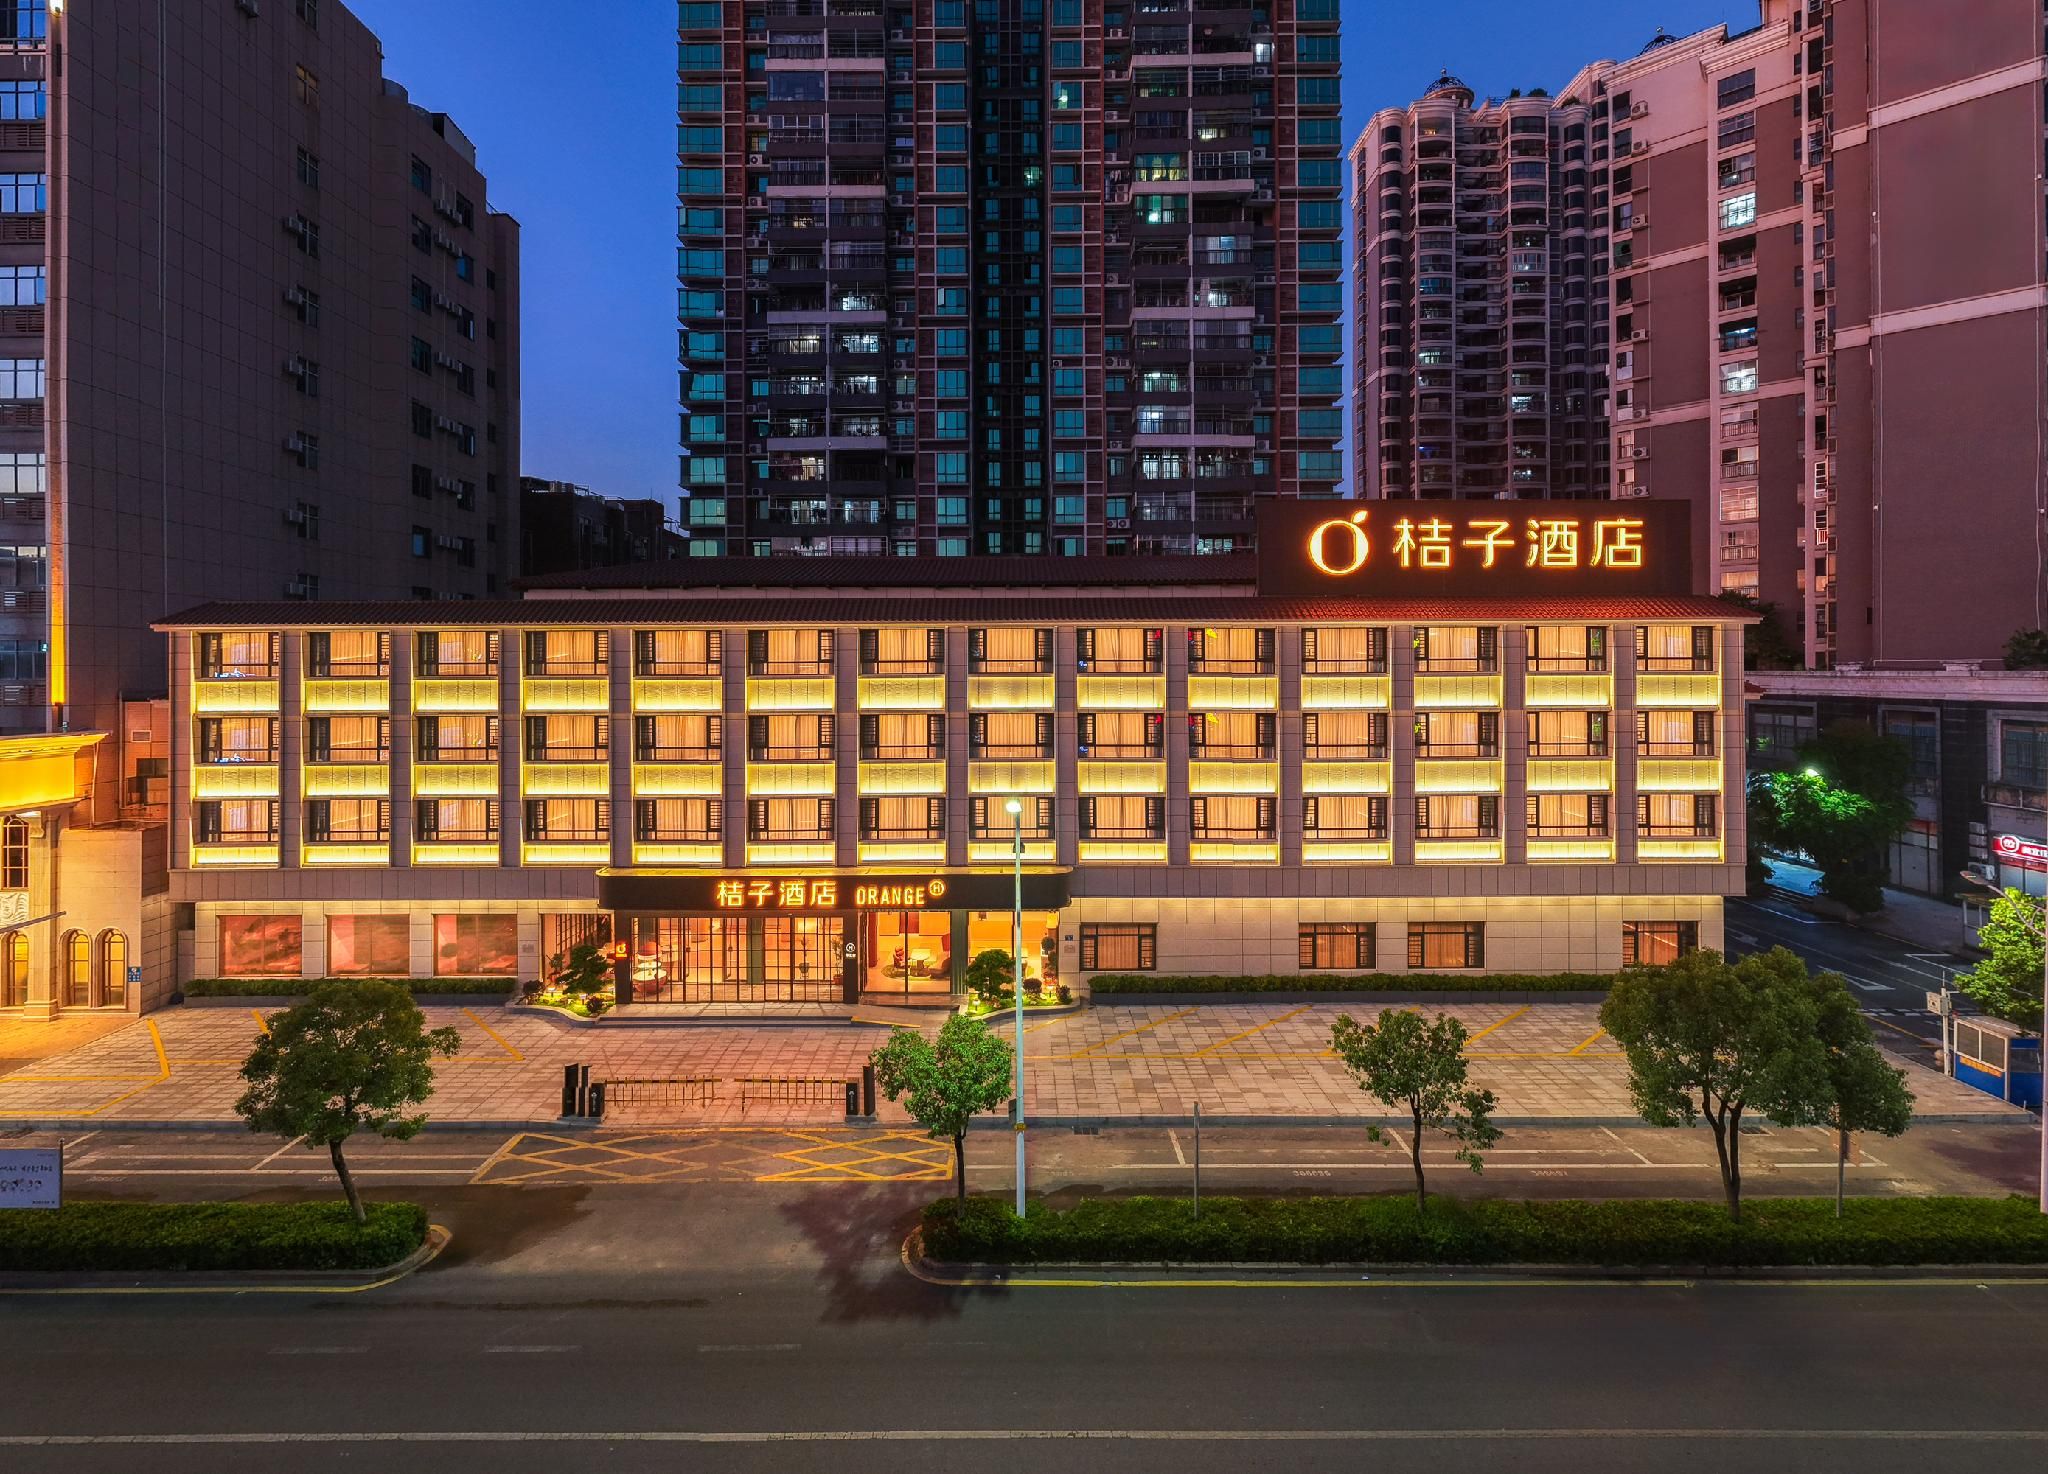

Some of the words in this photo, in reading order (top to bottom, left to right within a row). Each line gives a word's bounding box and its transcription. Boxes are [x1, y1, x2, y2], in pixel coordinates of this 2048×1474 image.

[1393, 517, 1643, 568] 桔子酒店
[716, 880, 836, 907] 桔子酒店
[856, 886, 925, 905] ORANGE
